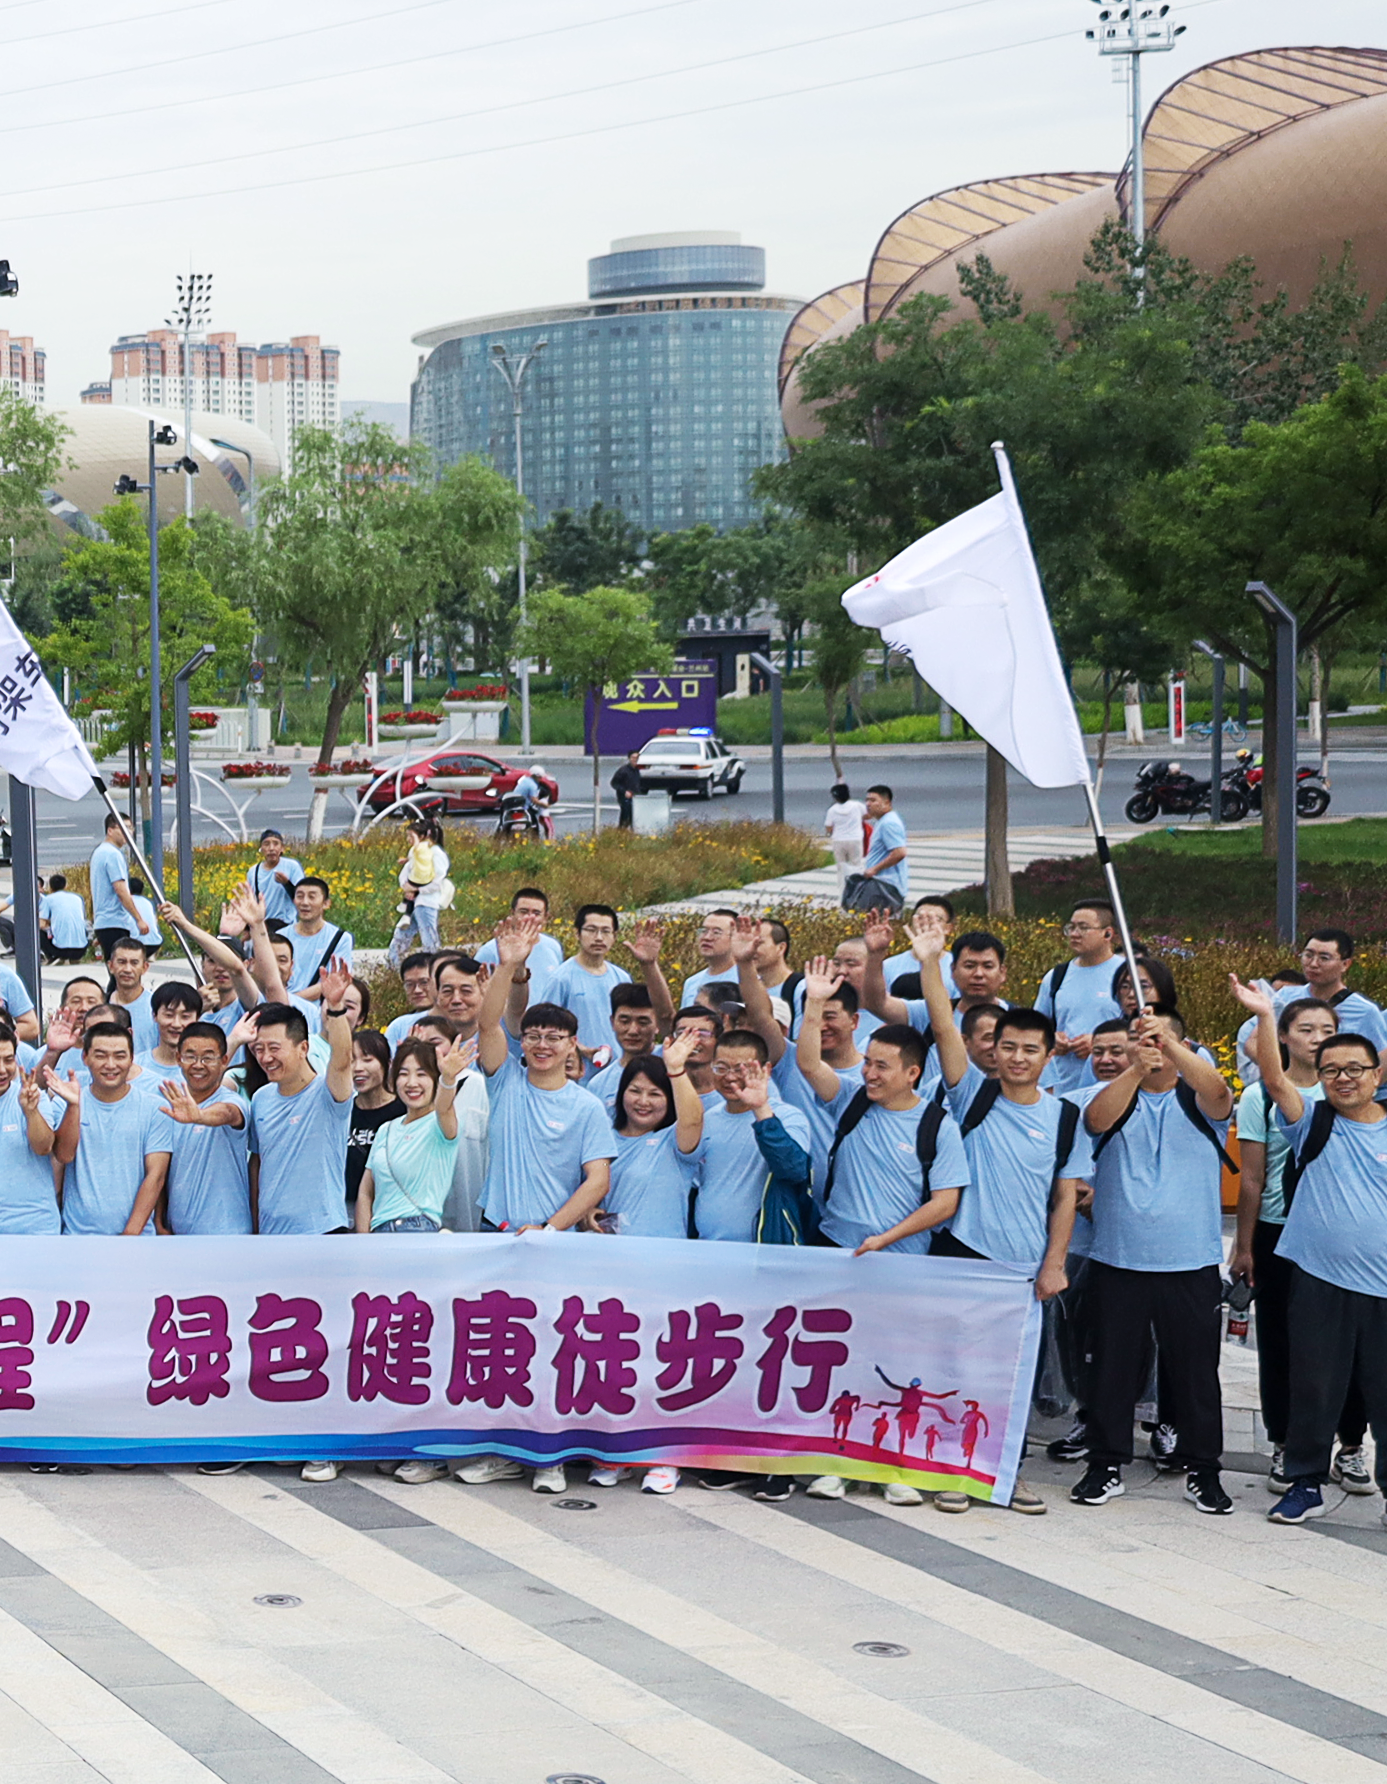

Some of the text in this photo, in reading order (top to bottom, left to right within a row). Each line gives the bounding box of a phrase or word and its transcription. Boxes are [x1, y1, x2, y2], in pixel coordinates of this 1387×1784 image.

[147, 1291, 853, 1415] 绿色健康徒步行
